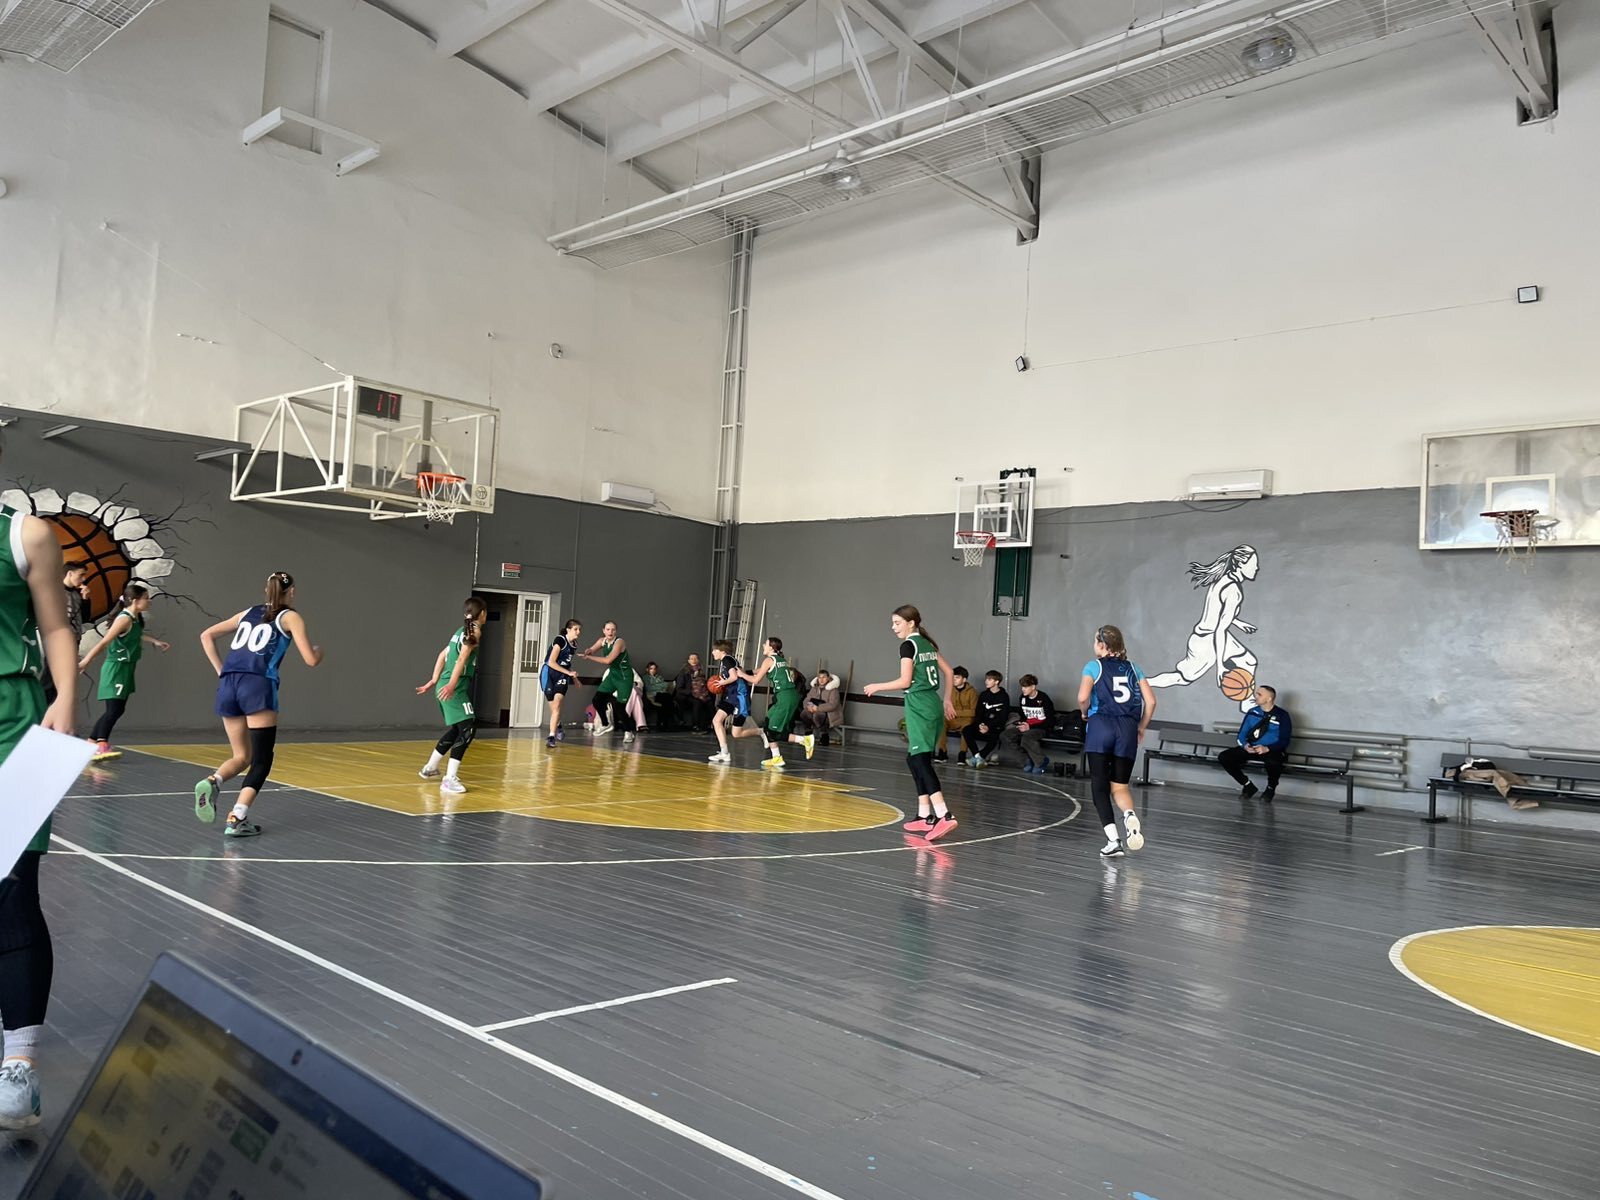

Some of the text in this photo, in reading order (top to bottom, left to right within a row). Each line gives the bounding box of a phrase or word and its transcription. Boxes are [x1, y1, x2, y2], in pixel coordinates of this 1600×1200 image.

[230, 620, 273, 653] 00
[115, 683, 124, 696] 7
[1112, 676, 1131, 704] 5
[462, 702, 474, 715] 10
